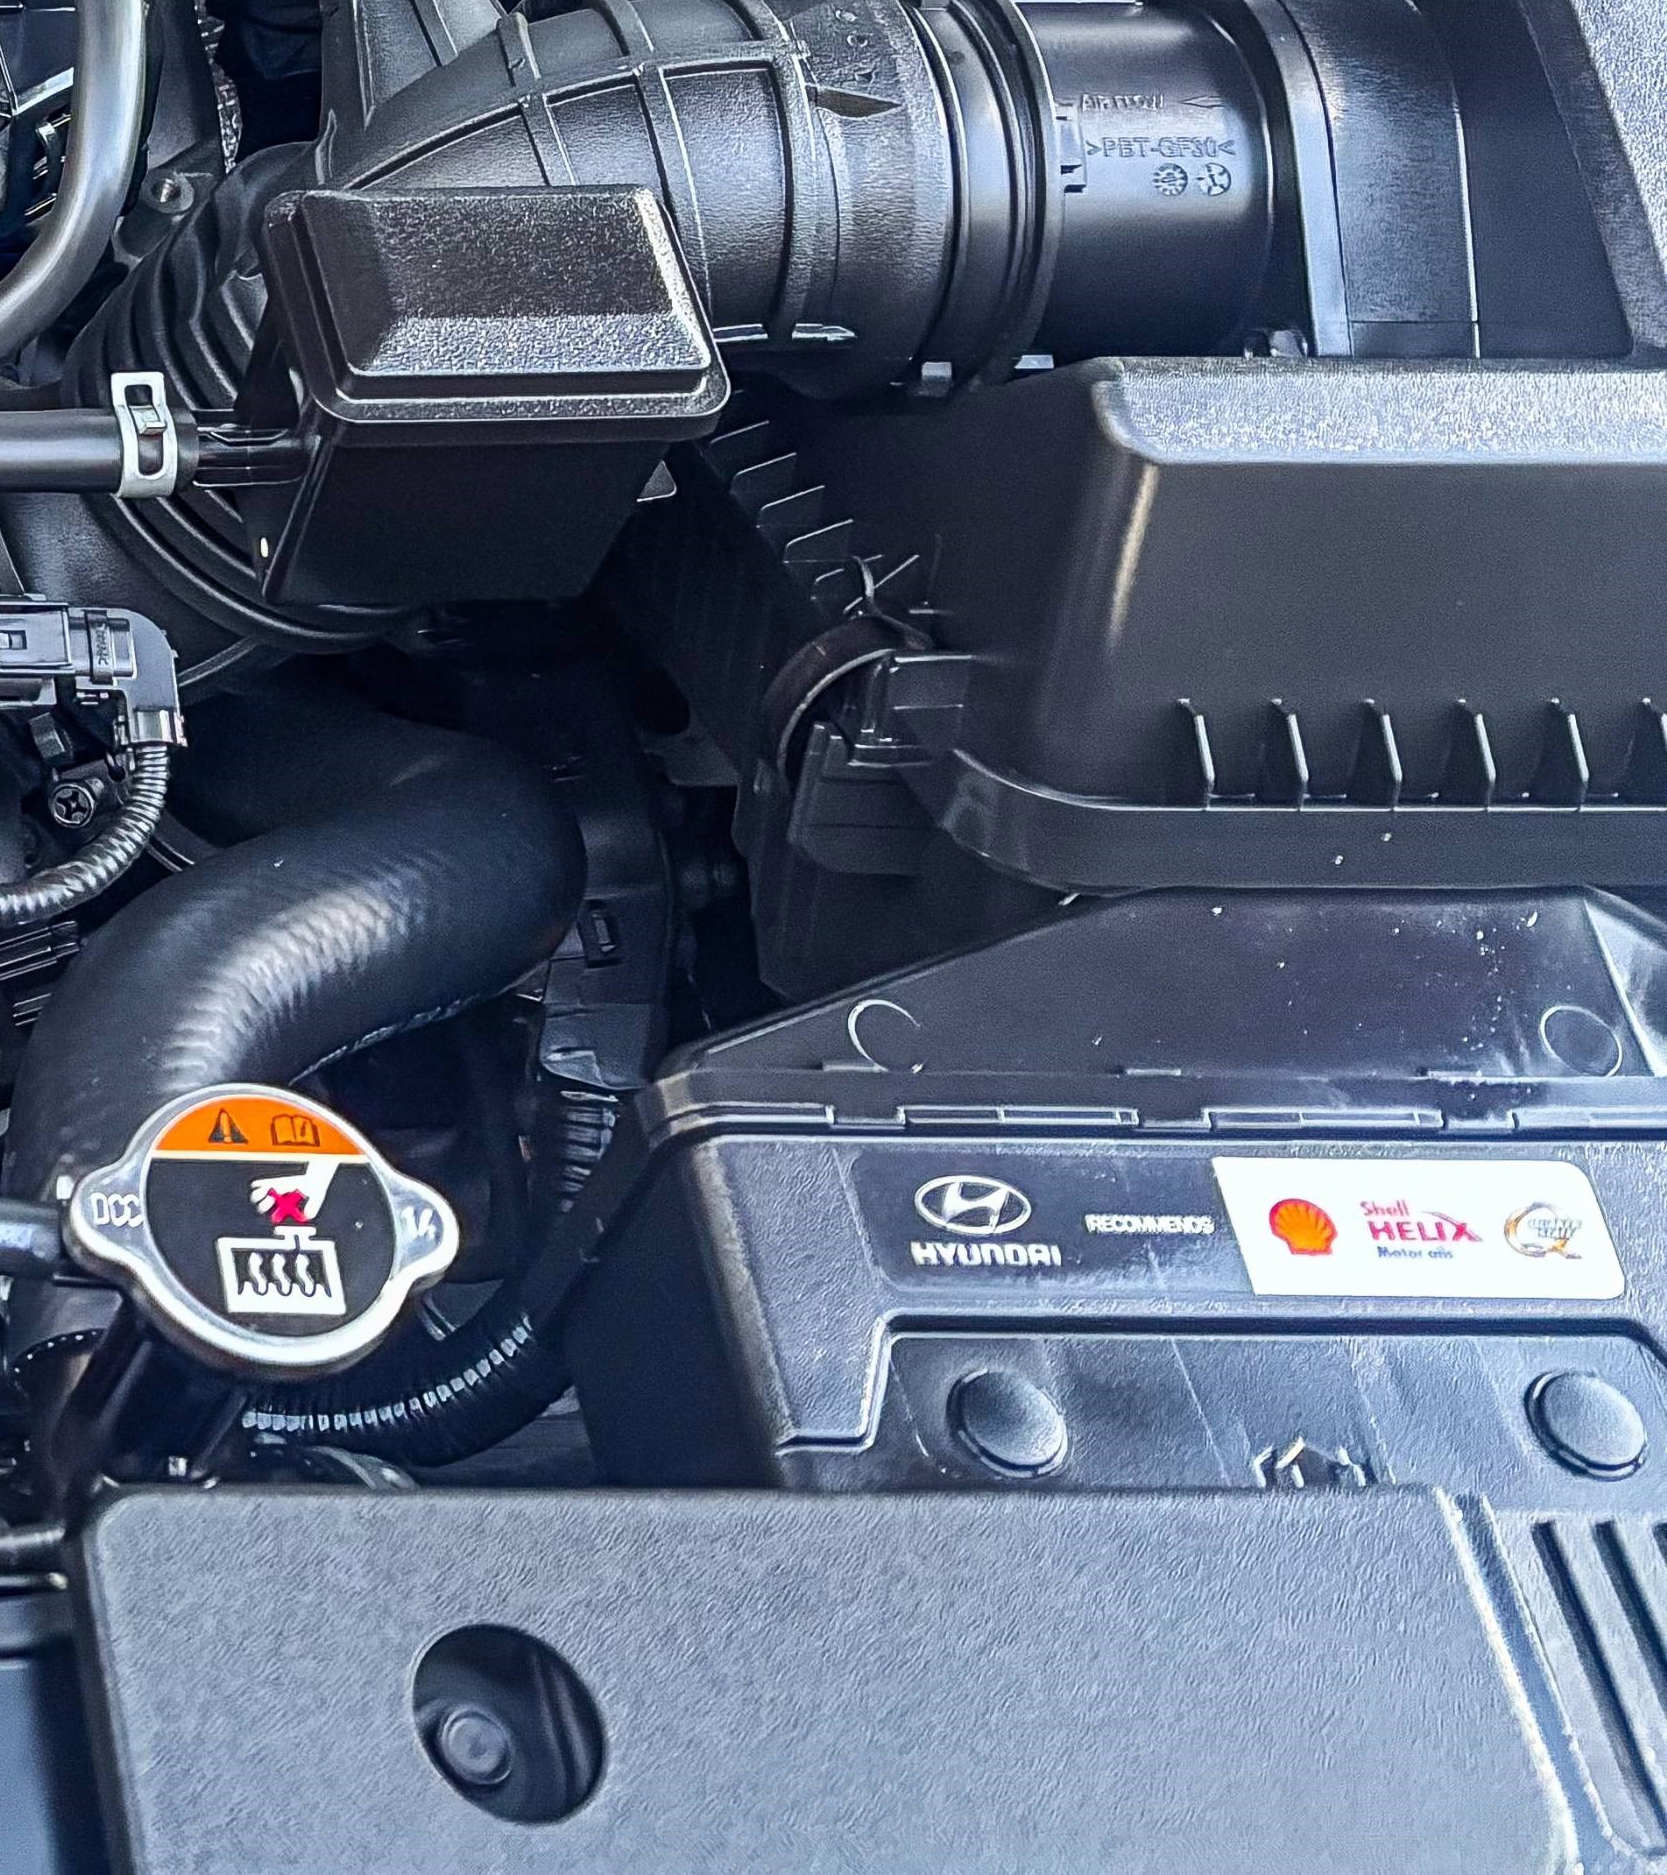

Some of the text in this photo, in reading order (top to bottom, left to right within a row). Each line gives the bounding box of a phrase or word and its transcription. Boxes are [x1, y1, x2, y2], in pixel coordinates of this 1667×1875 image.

[1084, 1213, 1215, 1235] RECOMMENDS
[1367, 1220, 1482, 1242] HELIX
[910, 1241, 1062, 1267] HYUNDAI
